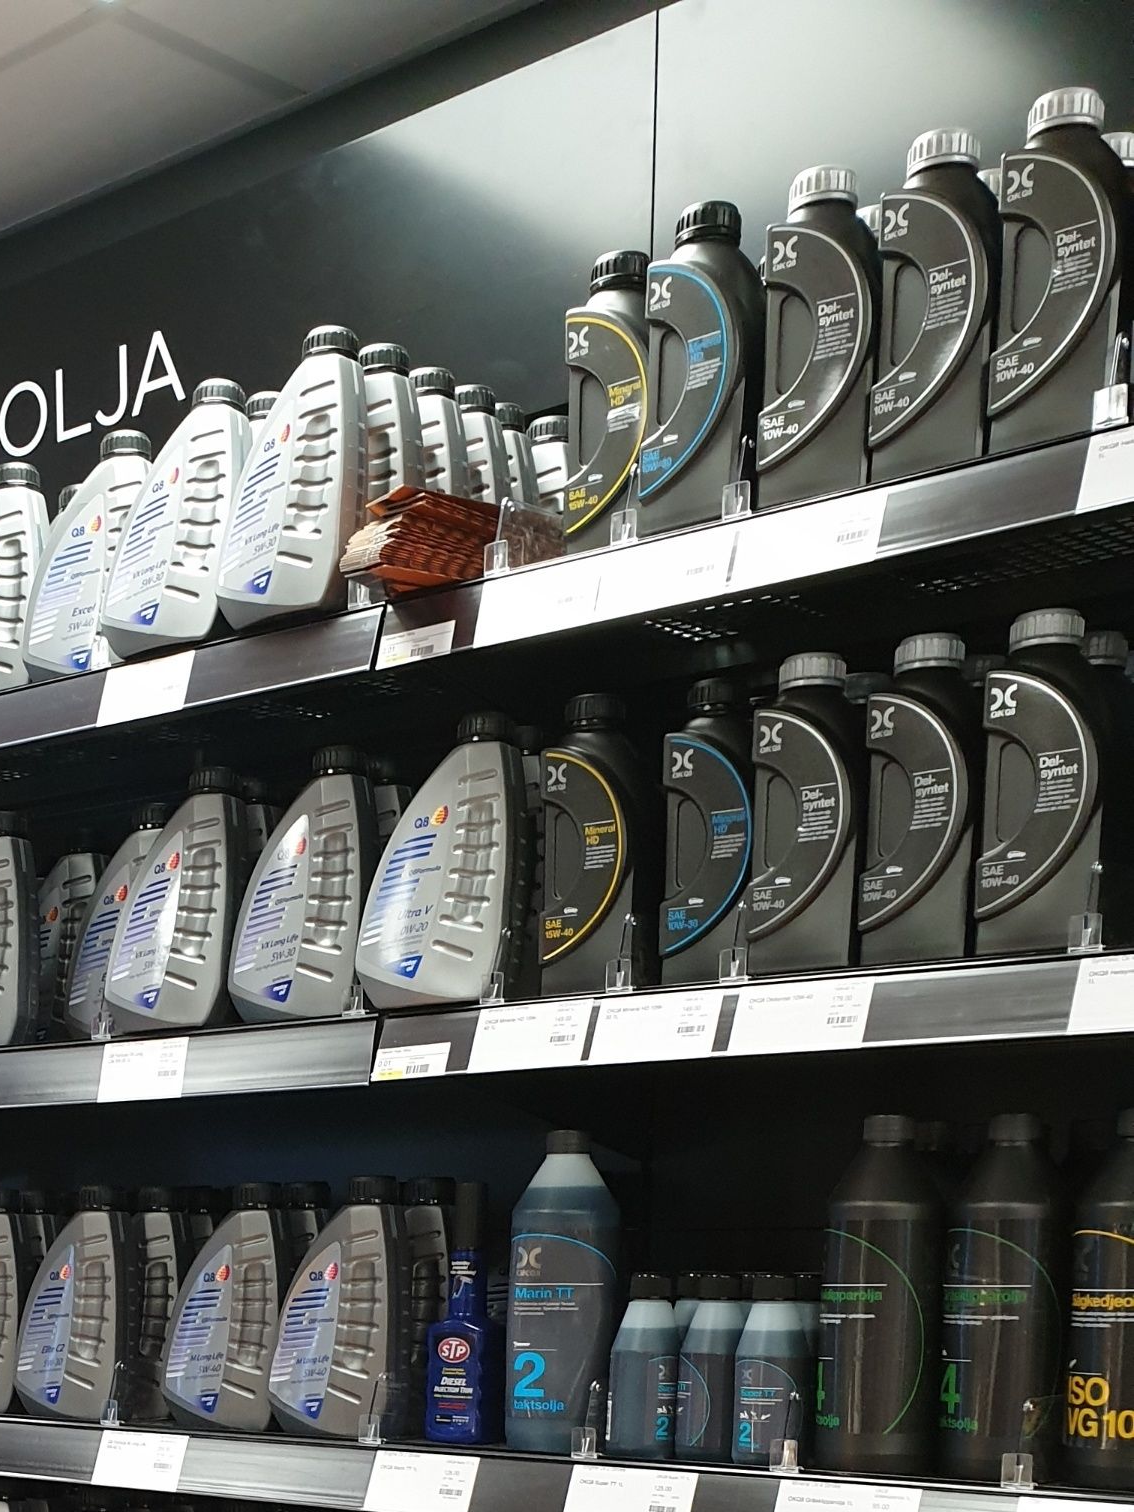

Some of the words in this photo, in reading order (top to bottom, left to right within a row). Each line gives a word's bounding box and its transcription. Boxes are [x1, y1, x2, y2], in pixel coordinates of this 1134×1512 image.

[1057, 236, 1096, 258] syntet
[930, 275, 967, 295] syntet
[818, 308, 854, 328] syntet
[996, 355, 1019, 371] SAE
[995, 362, 1035, 383] 10W-40
[874, 389, 895, 404] SAE
[873, 397, 910, 416] 10W-40
[763, 416, 785, 429] SAE
[762, 423, 799, 441] 10W-40
[263, 437, 276, 453] Q8
[568, 488, 586, 500] SAE
[71, 524, 85, 538] Q8
[1039, 762, 1079, 780] syntet
[914, 781, 949, 799] syntet
[802, 795, 836, 811] syntet
[414, 816, 430, 829] Q8
[584, 822, 617, 836] Mineral
[586, 835, 600, 846] HD
[981, 864, 1005, 878] SAE
[863, 879, 883, 892] SAE
[981, 873, 1020, 888] 10W-40
[753, 890, 773, 902] SAE
[863, 888, 897, 903] 10W-40
[752, 899, 785, 912] 10W-40
[544, 919, 563, 930] SAE
[203, 1271, 216, 1283] Q8
[309, 1272, 324, 1283] Q8
[514, 1286, 552, 1300] Marin
[555, 1286, 575, 1300] TT
[440, 1340, 468, 1362] STP
[440, 1375, 468, 1387] DIESEL
[513, 1351, 547, 1399] 2
[940, 1364, 962, 1414] 4
[1068, 1376, 1111, 1407] ISO
[513, 1399, 565, 1412] taktsolja
[655, 1416, 669, 1437] 2
[1068, 1407, 1098, 1438] VG
[738, 1421, 752, 1443] 2
